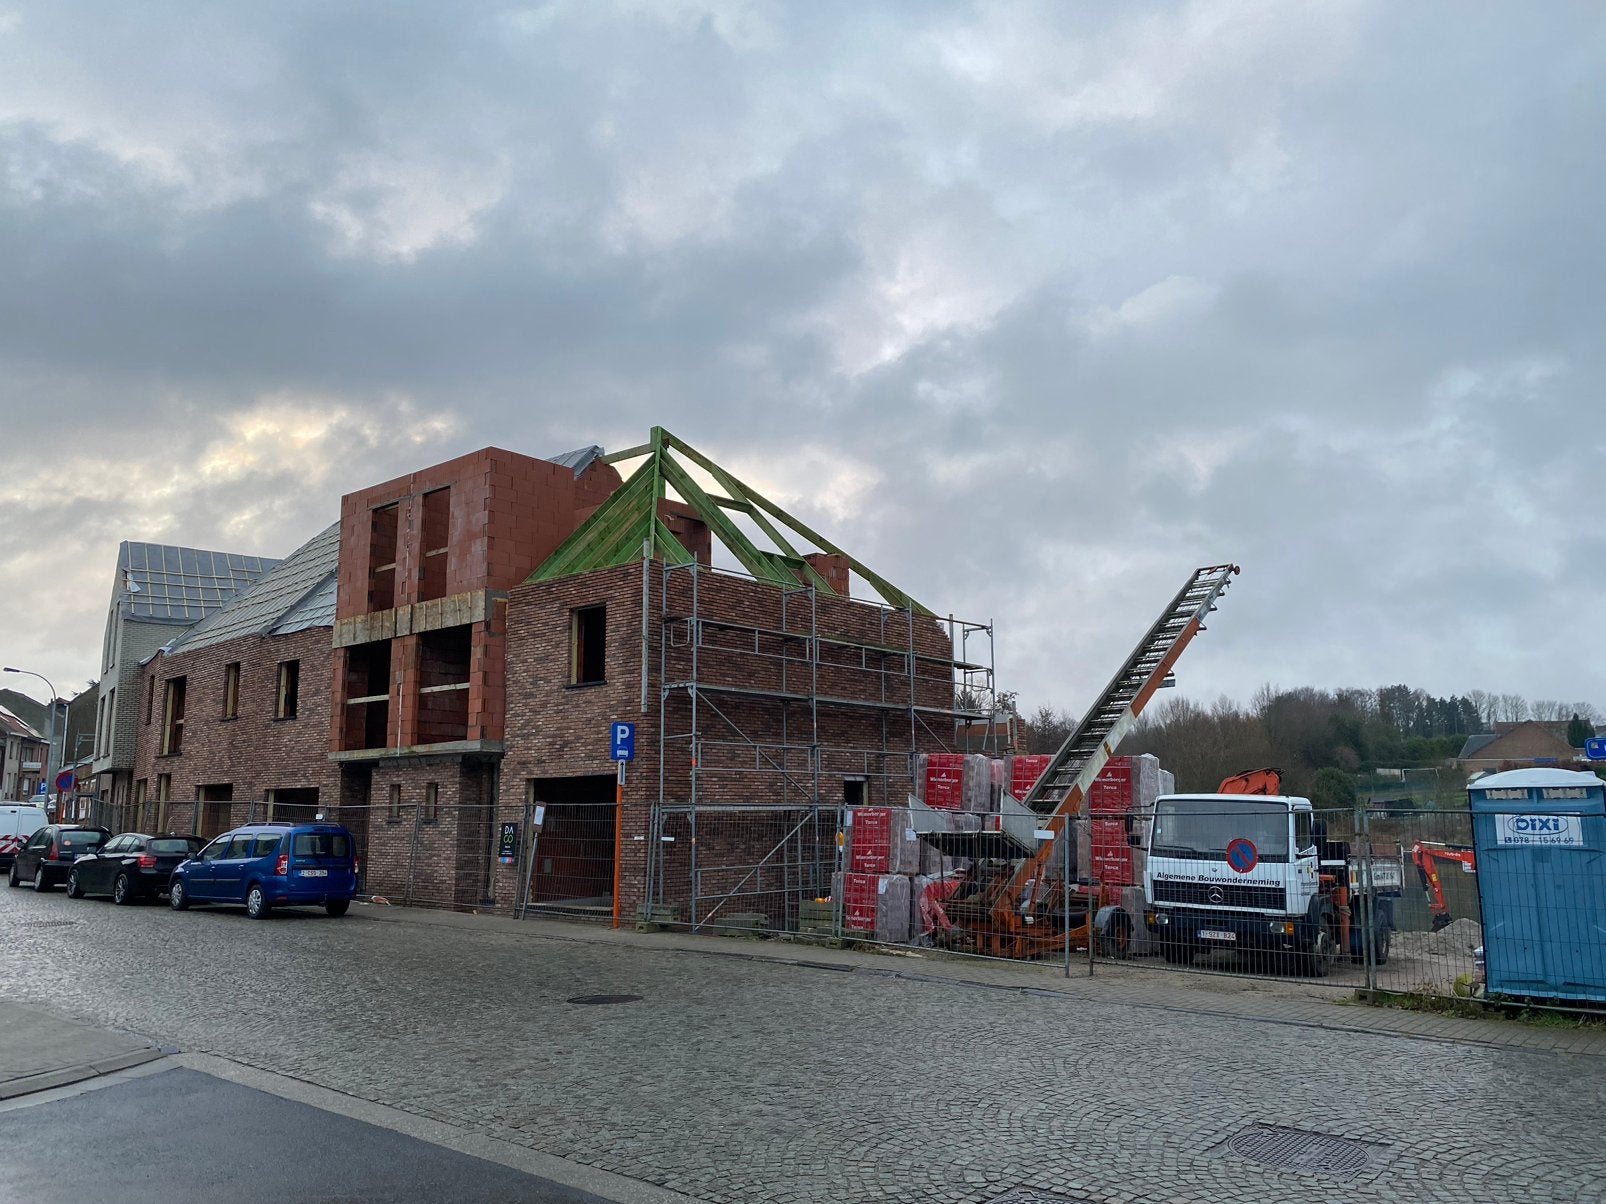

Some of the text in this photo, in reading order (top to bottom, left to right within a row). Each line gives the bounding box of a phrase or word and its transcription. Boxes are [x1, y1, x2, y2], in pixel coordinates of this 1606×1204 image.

[616, 725, 630, 745] P
[1513, 836, 1530, 844] 078
[1551, 836, 1561, 844] 69
[1156, 872, 1281, 887] Algemene Bouwonderneming
